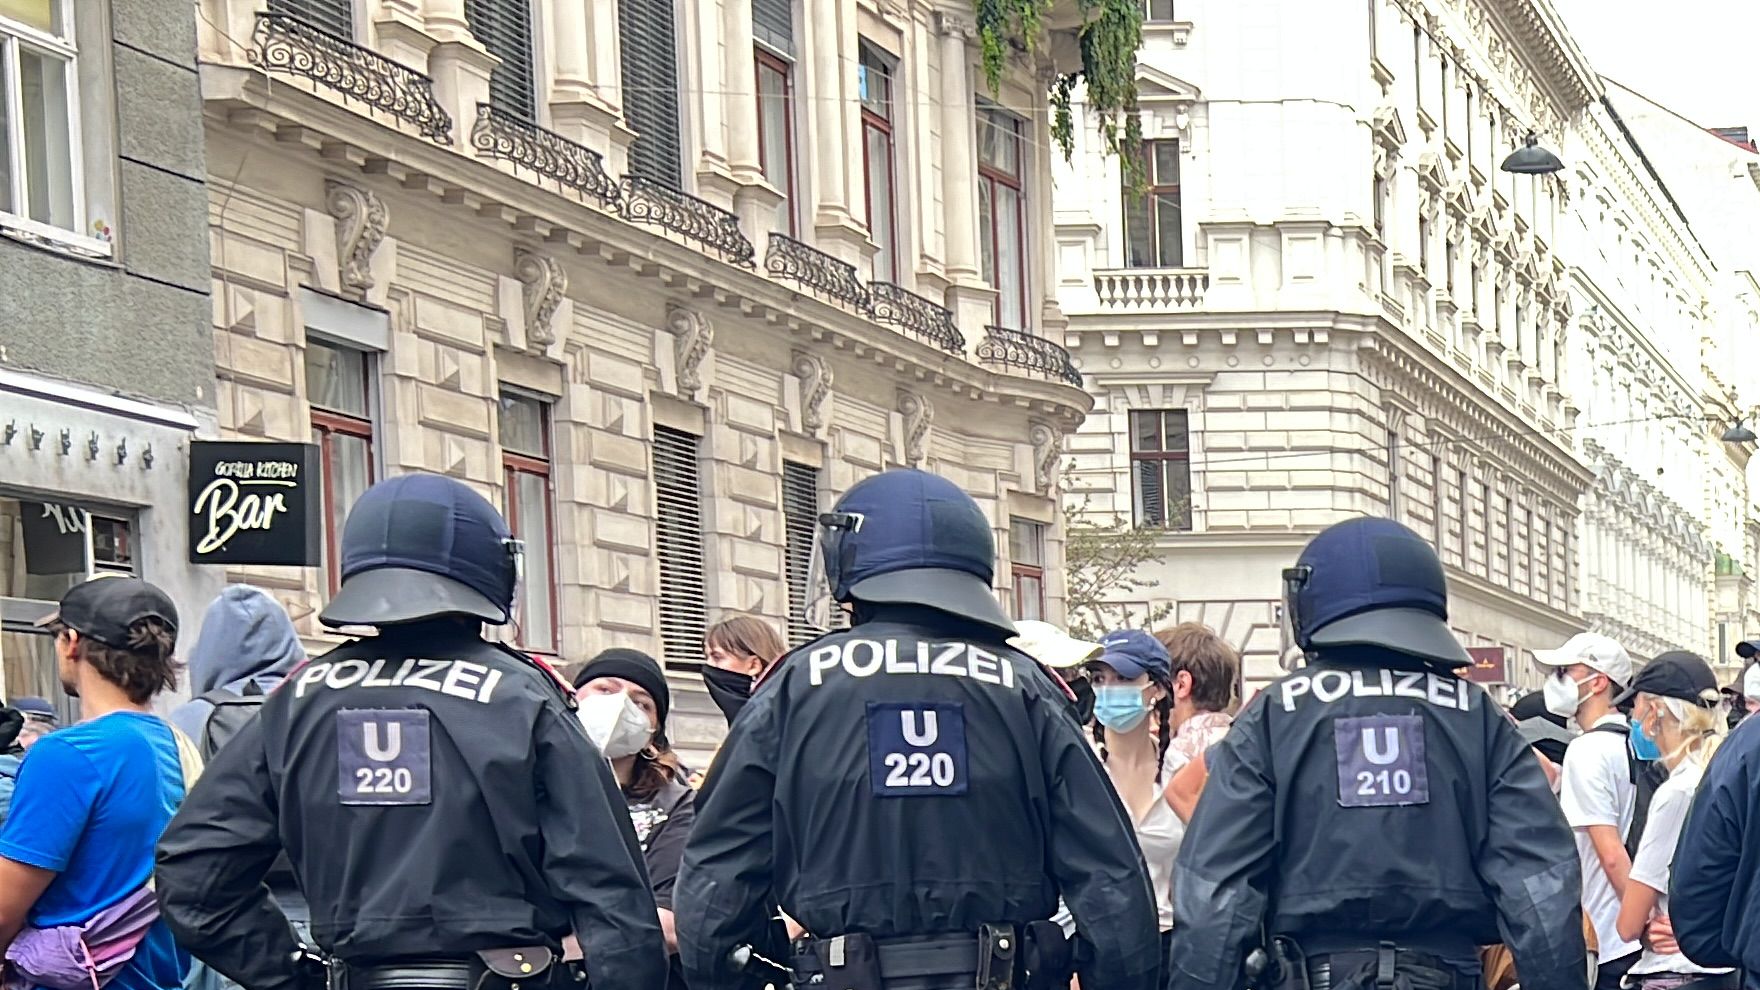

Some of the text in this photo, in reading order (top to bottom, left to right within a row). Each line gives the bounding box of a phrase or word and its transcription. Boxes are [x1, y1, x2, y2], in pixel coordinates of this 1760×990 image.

[256, 461, 298, 478] KITCHEN
[193, 478, 288, 554] Bar
[294, 658, 503, 703] POLIZEI
[809, 638, 1014, 689] POLIZEI
[1281, 668, 1469, 712] POLIZEI
[362, 721, 401, 762] U
[900, 710, 938, 747] U
[1361, 726, 1400, 765] U
[356, 767, 412, 793] 220
[884, 752, 955, 787] 220
[1356, 769, 1411, 796] 210
